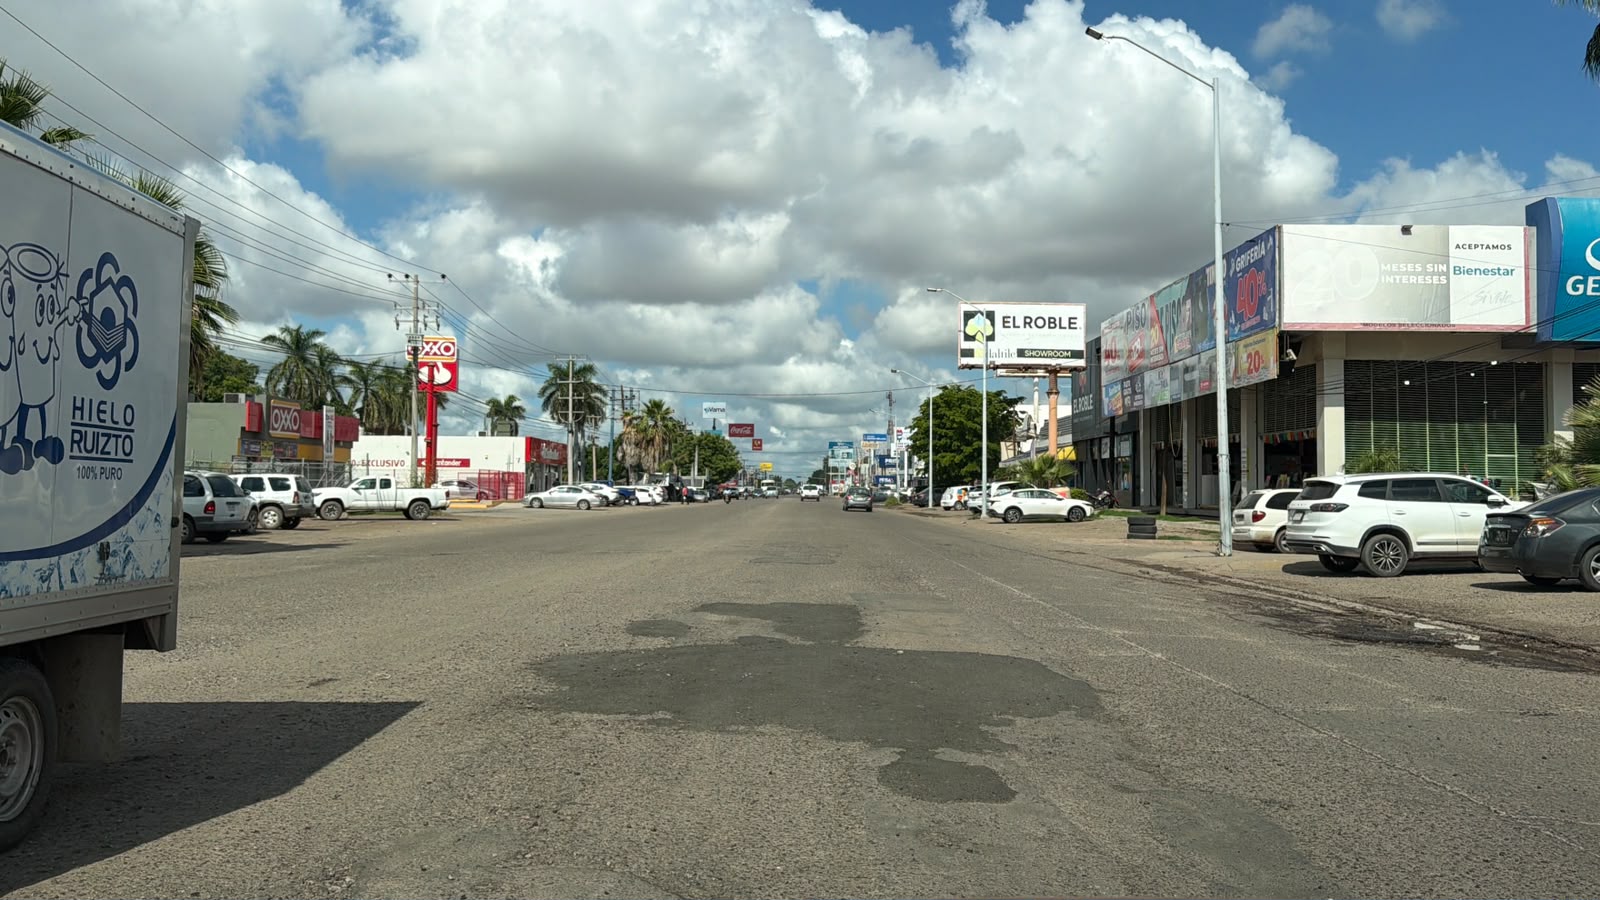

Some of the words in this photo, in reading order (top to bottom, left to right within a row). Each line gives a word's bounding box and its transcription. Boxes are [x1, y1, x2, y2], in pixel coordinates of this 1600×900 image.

[1454, 243, 1512, 251] ACEPTAMOS
[1381, 263, 1422, 272] MESES
[1426, 263, 1447, 272] SIN
[1453, 265, 1515, 276] Bienestar
[1381, 275, 1447, 284] INTERESES
[1002, 316, 1020, 329] EL
[1024, 316, 1078, 330] ROBLE
[1024, 350, 1072, 358] SHOWROOM
[72, 396, 135, 427] HIELO
[272, 408, 300, 431] OXXO
[70, 429, 134, 457] RUIZTO
[362, 459, 405, 467] EXCLUSIVO
[77, 465, 97, 480] 100%
[100, 466, 123, 481] PURO
